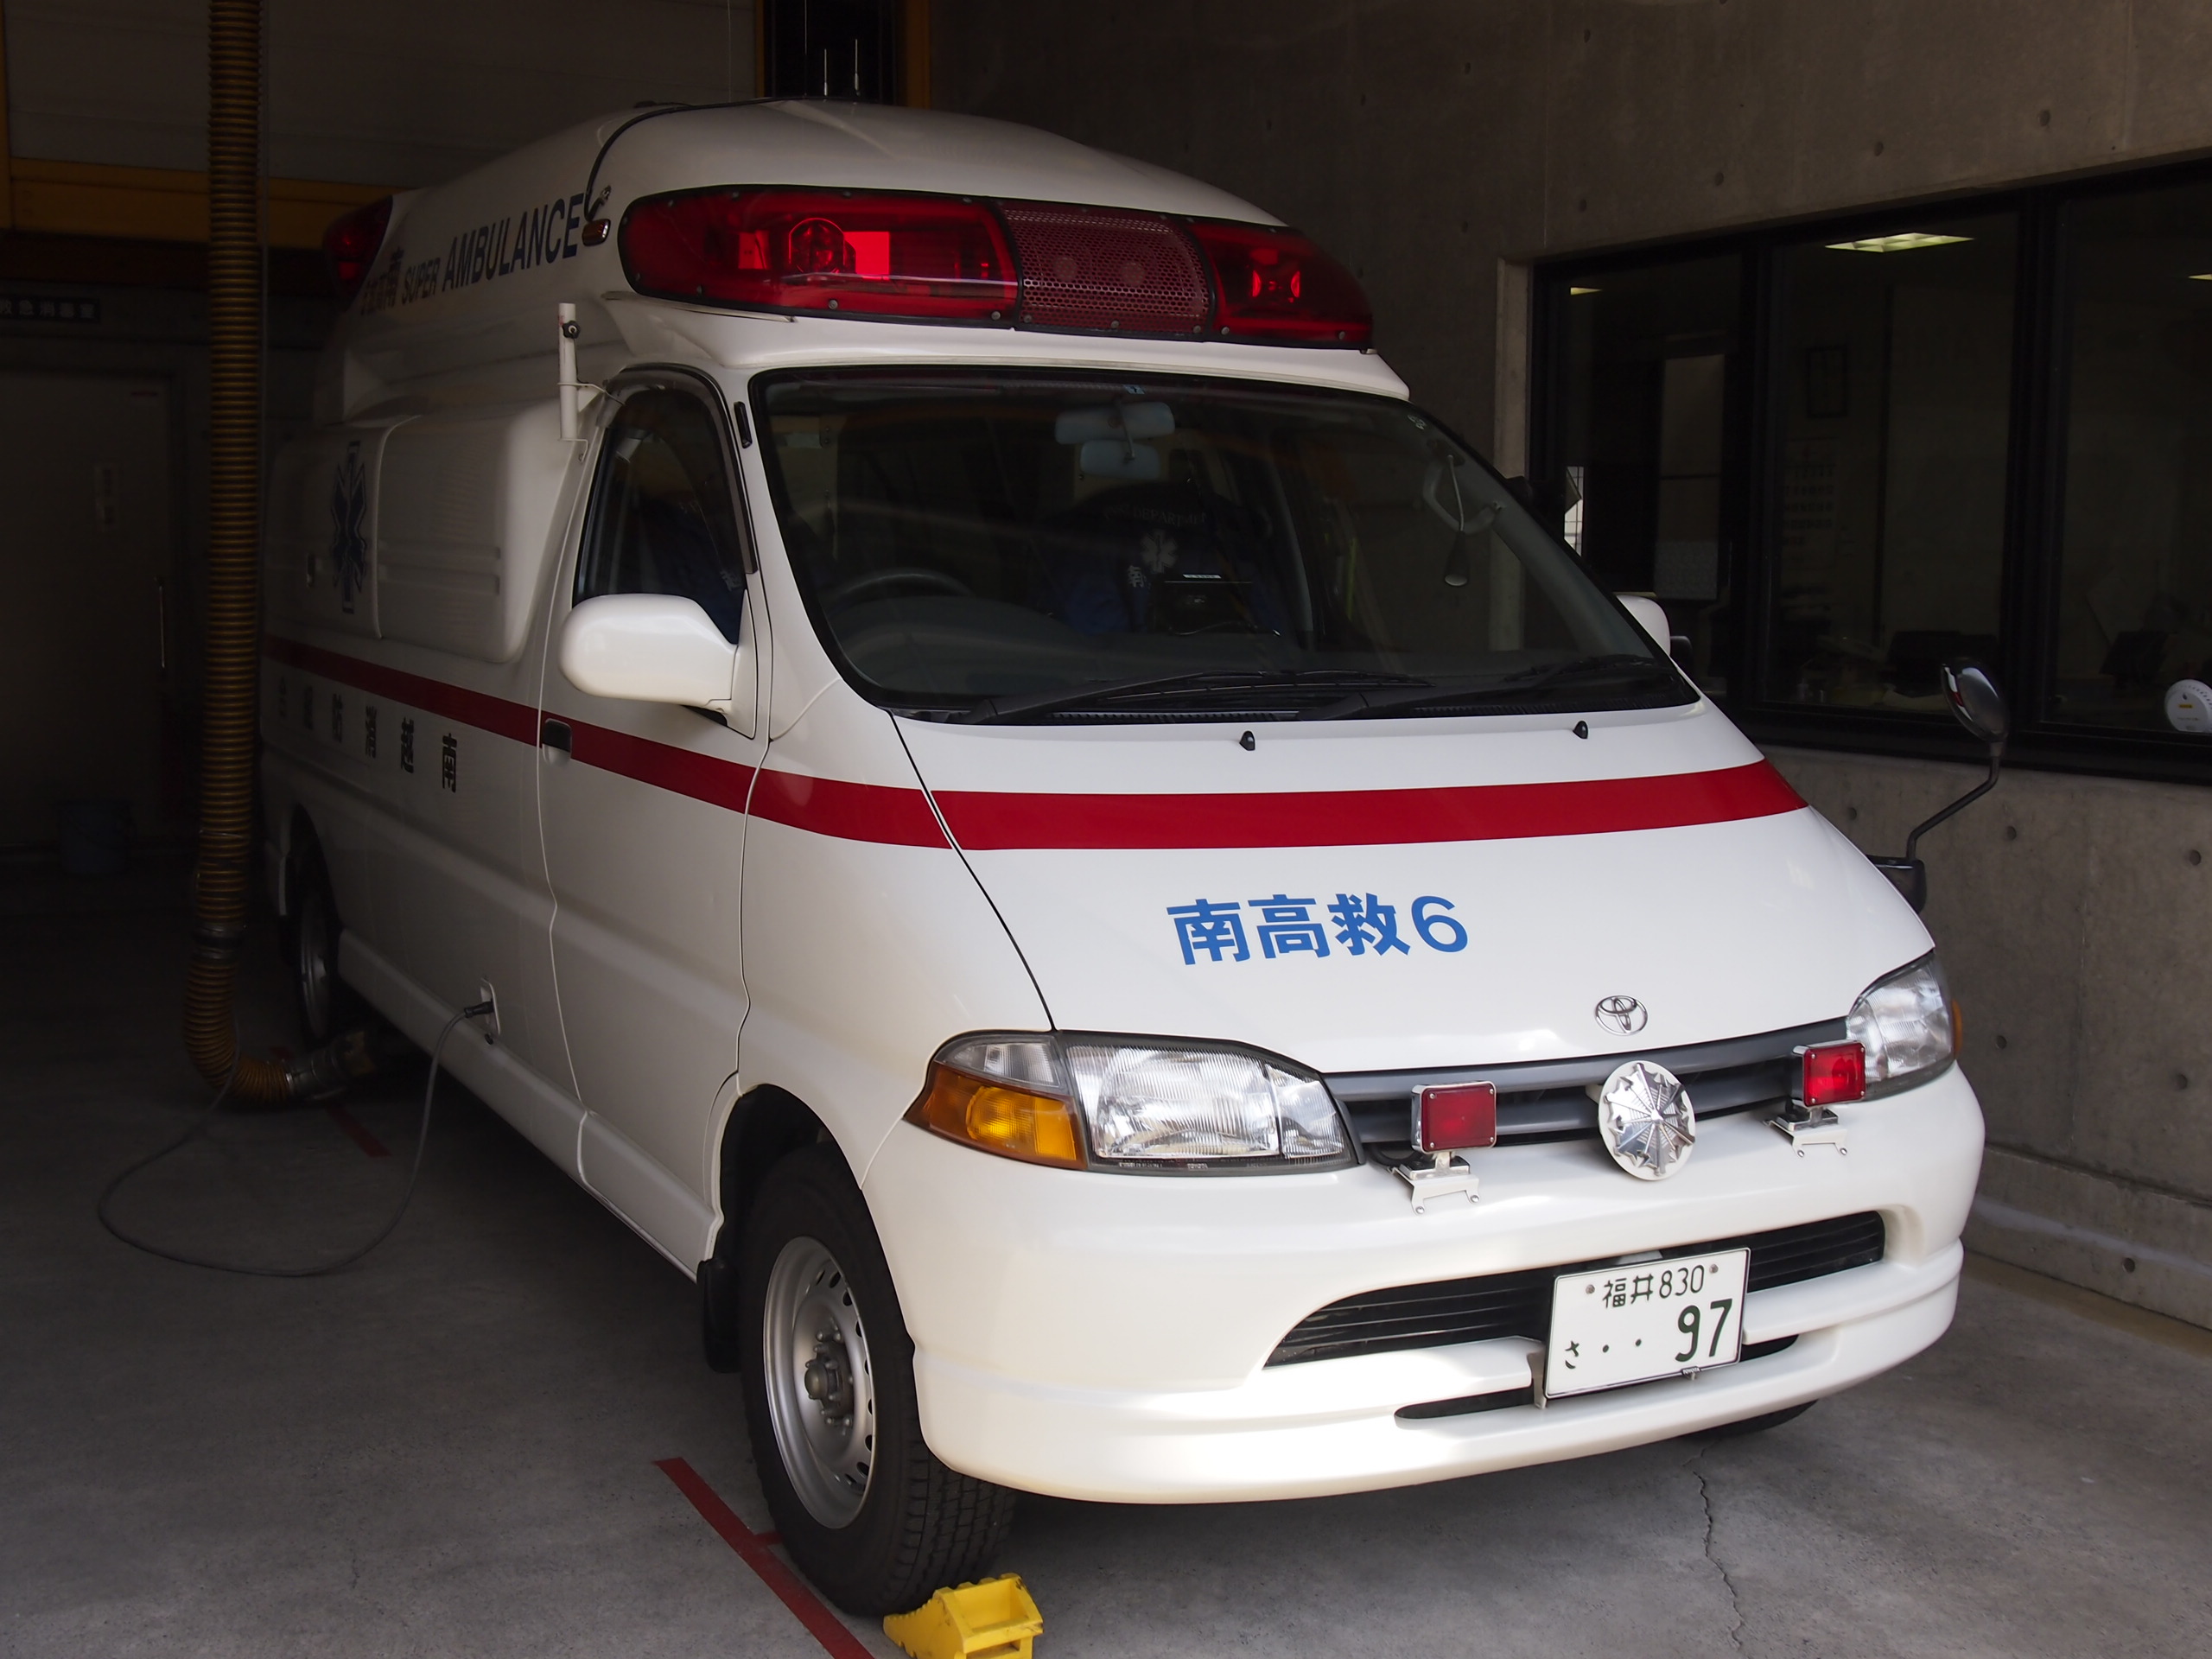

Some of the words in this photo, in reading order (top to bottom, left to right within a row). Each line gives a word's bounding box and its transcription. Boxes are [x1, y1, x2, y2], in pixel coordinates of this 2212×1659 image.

[401, 257, 441, 304] SUPER
[442, 193, 584, 292] AMBULANCE
[1166, 893, 1468, 965] 南高救6
[1565, 1340, 1580, 1370] さ
